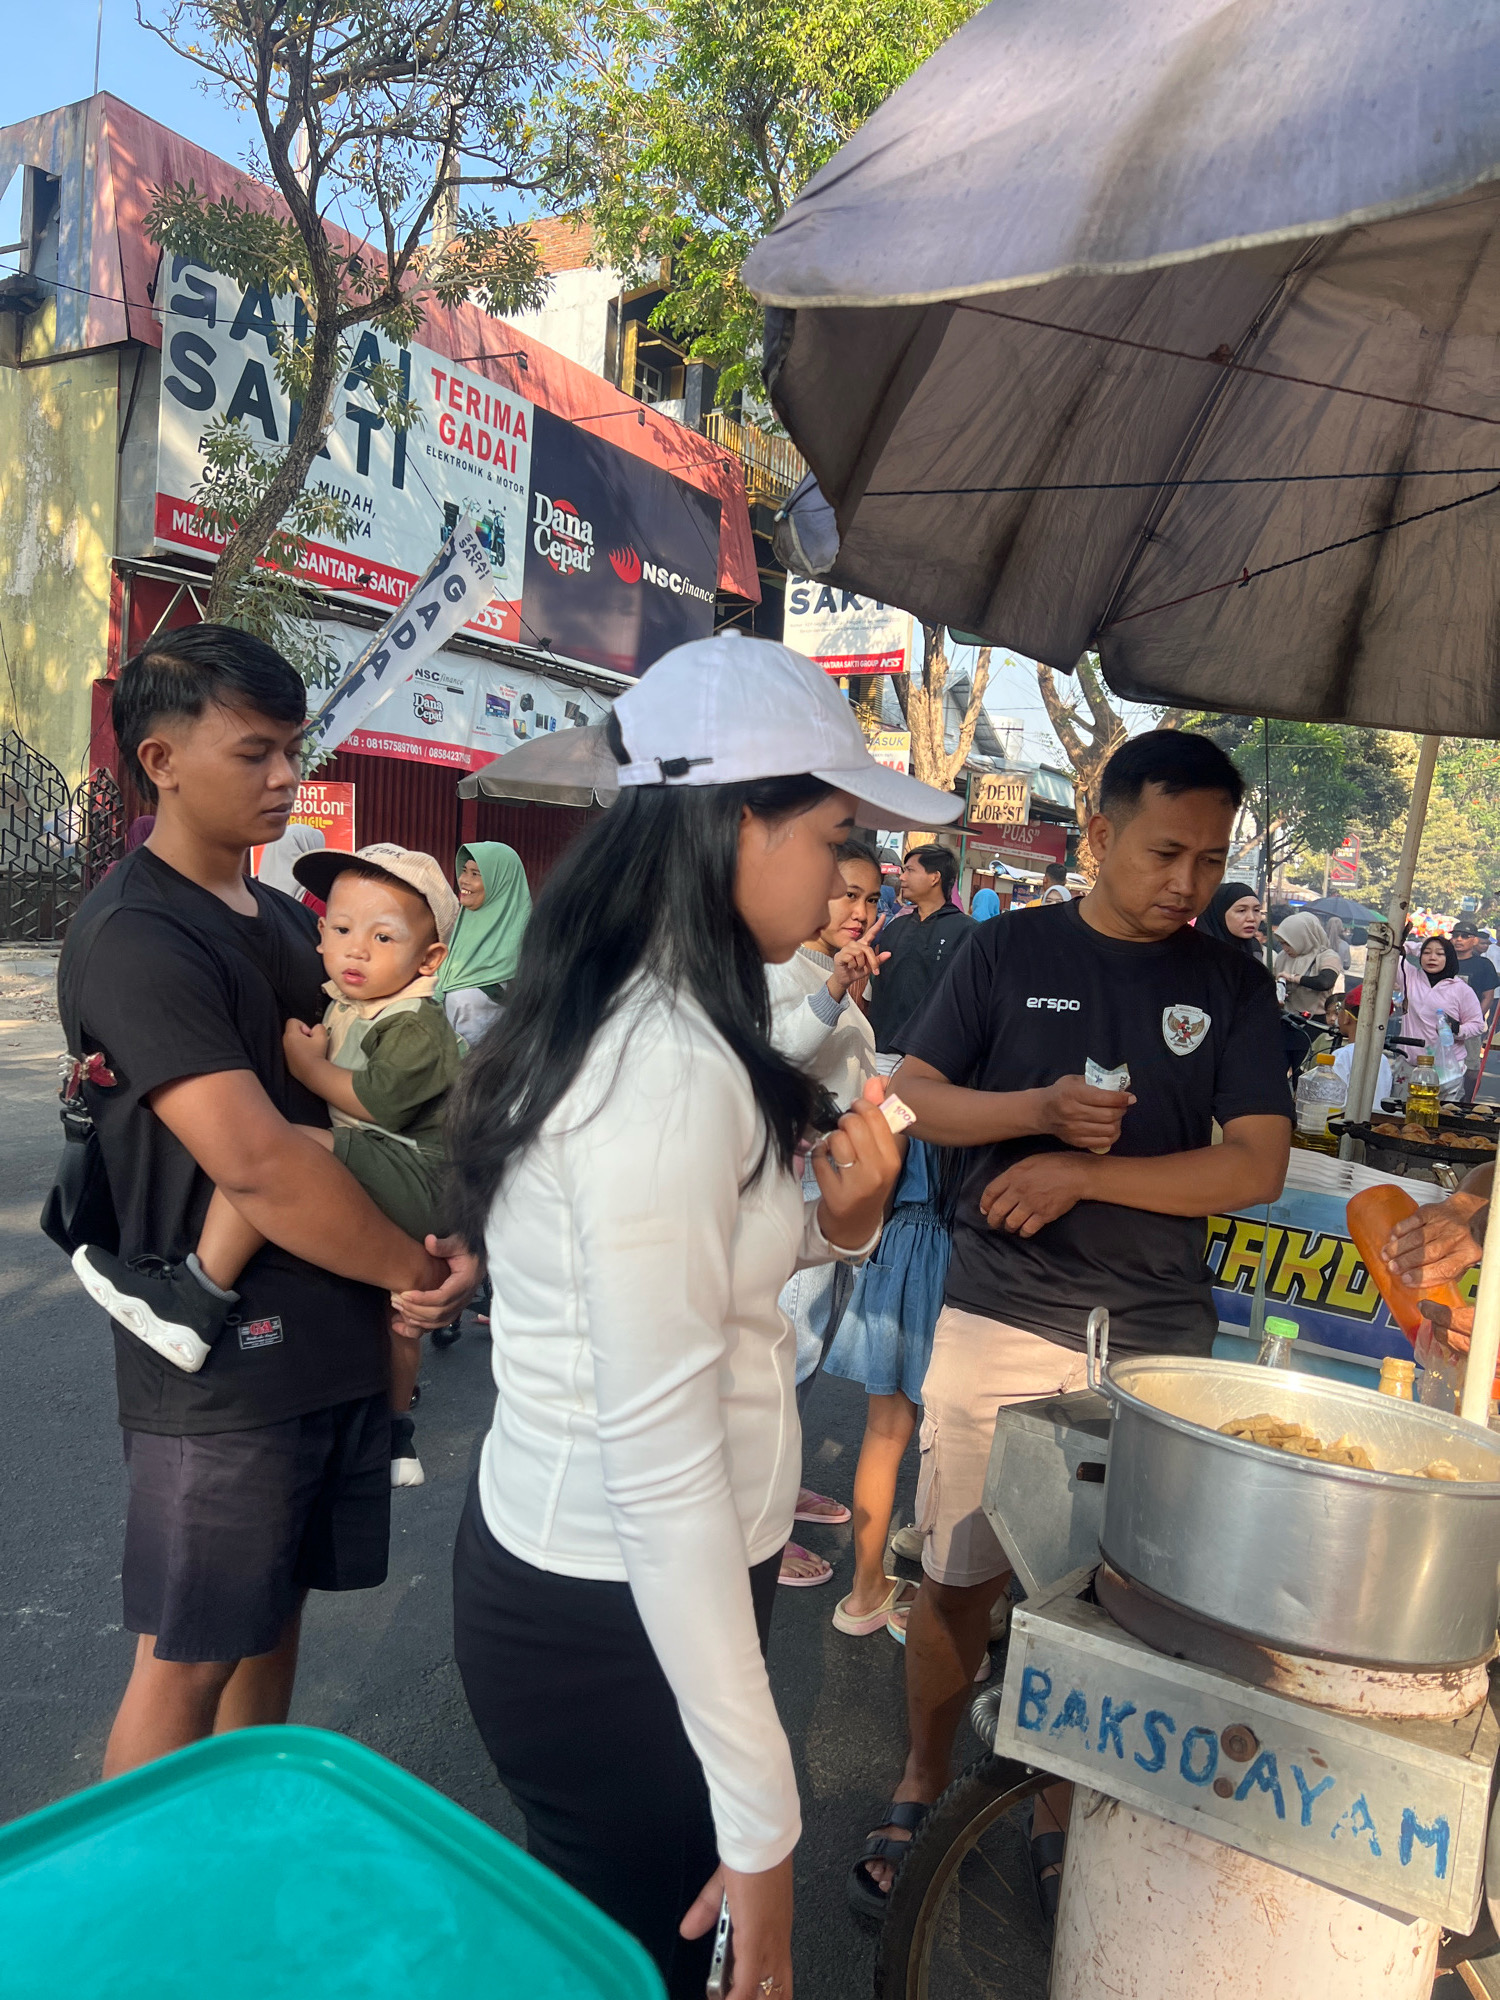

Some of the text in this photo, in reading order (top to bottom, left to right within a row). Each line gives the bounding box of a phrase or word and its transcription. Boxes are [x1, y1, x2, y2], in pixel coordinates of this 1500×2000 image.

[171, 254, 411, 412] GAAI
[431, 367, 527, 443] TERIMA
[439, 413, 517, 474] GADAI
[426, 445, 525, 495] ELEKTRONIK & MOTOR
[533, 491, 593, 545] Dana
[459, 539, 486, 580] SAKTI
[534, 525, 592, 573] Cepat
[789, 586, 899, 616] SAK
[414, 693, 443, 712] Dana
[414, 705, 443, 723] Cepat
[987, 784, 1024, 802] DEWI
[1026, 996, 1081, 1012] erspo
[1016, 1665, 1451, 1880] BAKSO AYAM
